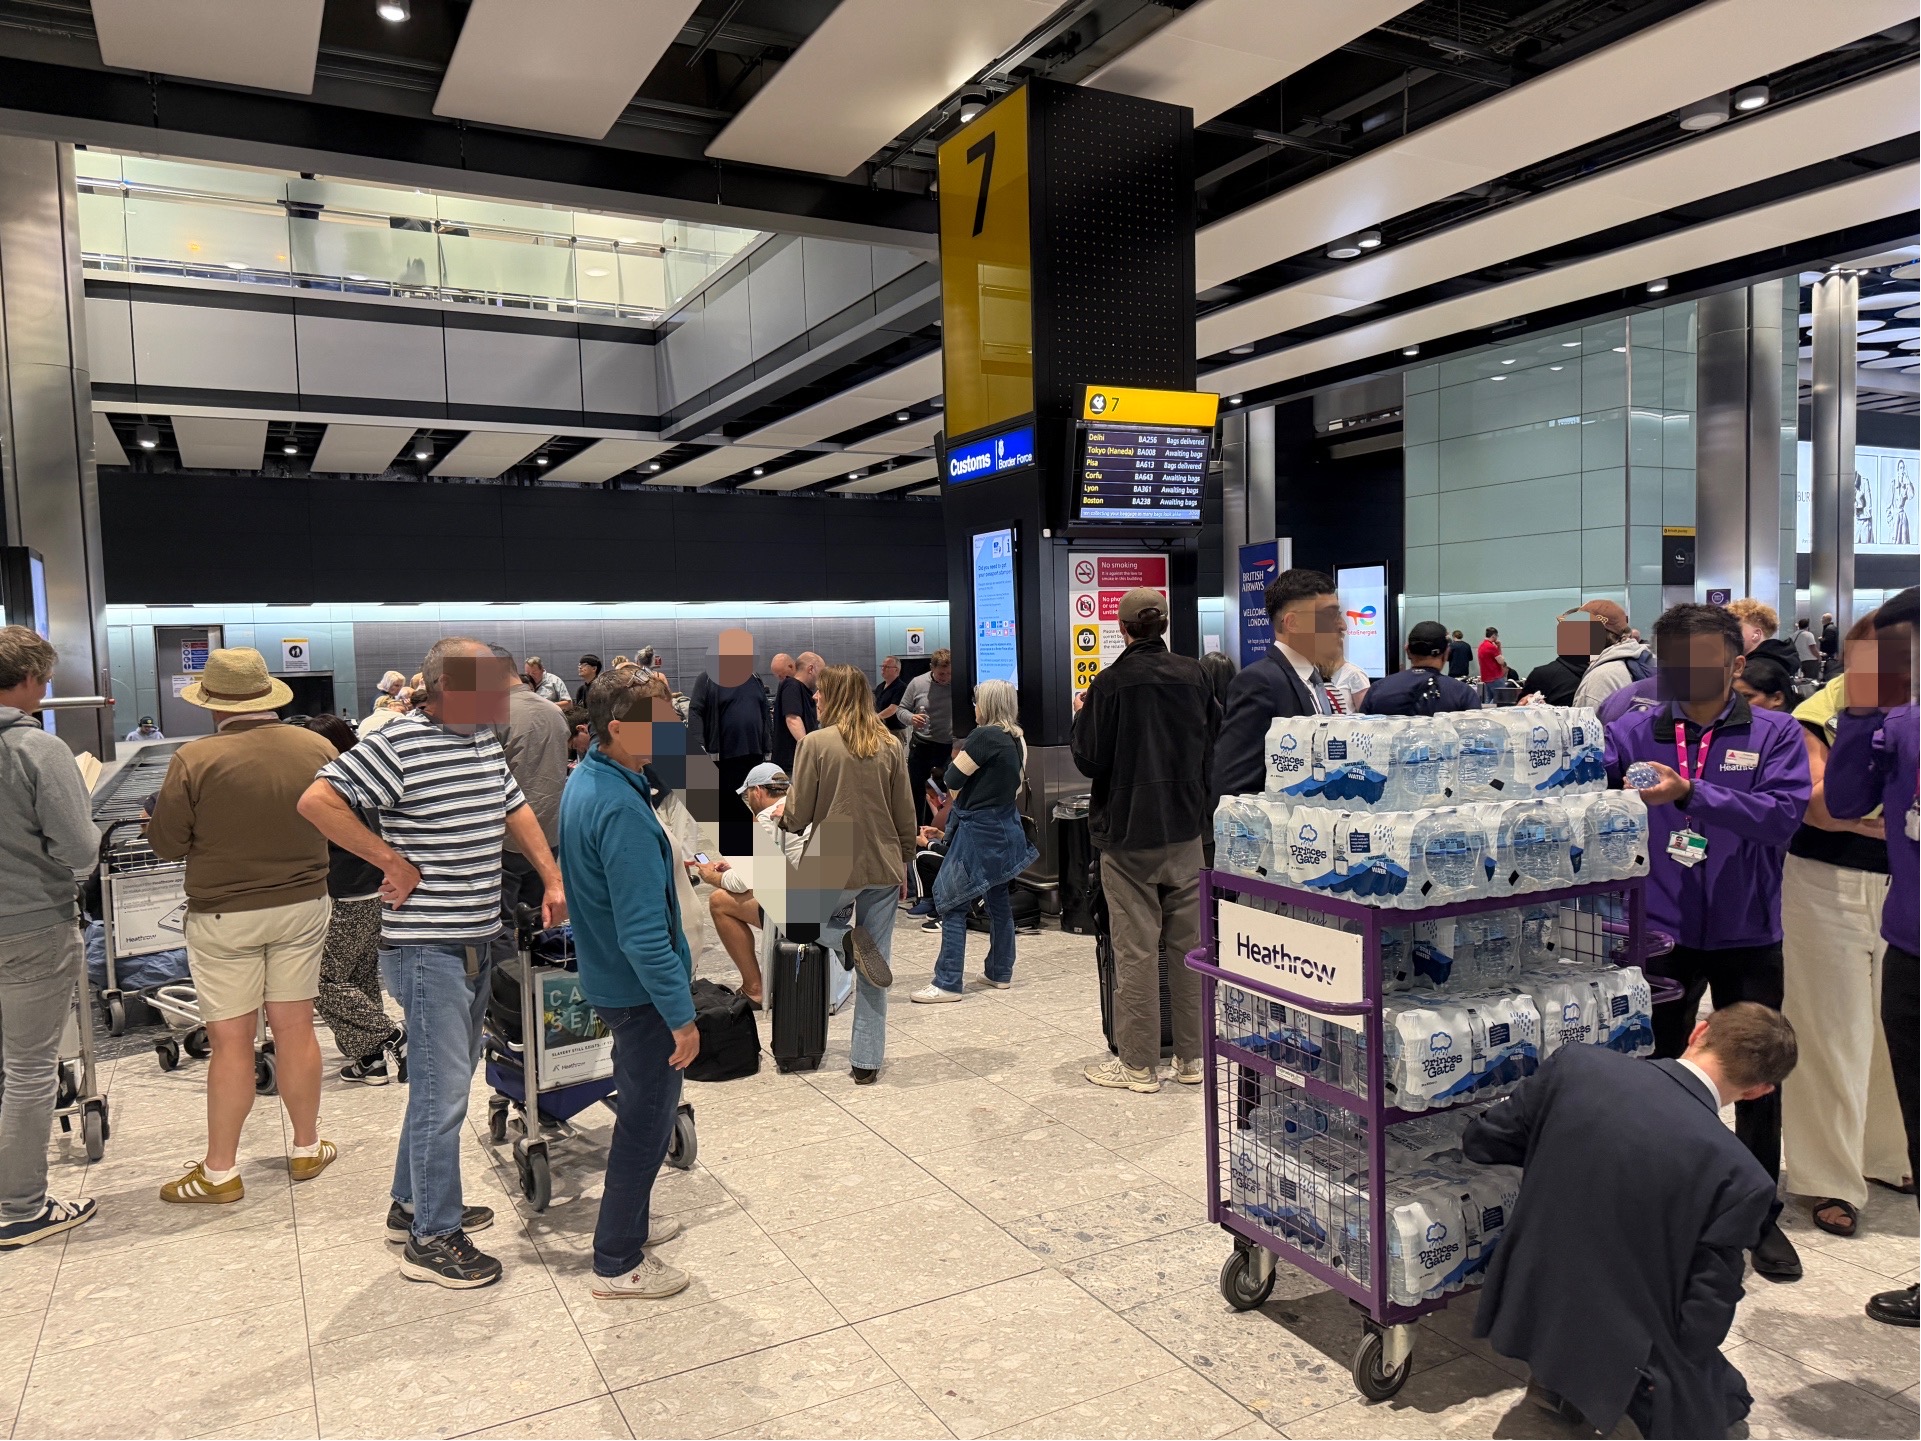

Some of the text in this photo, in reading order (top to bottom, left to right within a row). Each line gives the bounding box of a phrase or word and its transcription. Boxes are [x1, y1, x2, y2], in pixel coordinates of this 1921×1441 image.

[966, 131, 996, 238] 7
[1111, 397, 1120, 412] 7
[1088, 433, 1205, 446] Delhi BA256 Bags delivered
[1088, 446, 1203, 459] Tokyo (Haneda) BA008 Awaiting bags
[950, 452, 1032, 476] Customs Border Force
[1136, 460, 1155, 468] BA613
[1164, 462, 1177, 470] Bags
[1178, 462, 1202, 470] delivered
[1085, 472, 1102, 480] Corfu
[1162, 474, 1187, 483] Awaiting
[1187, 474, 1200, 483] bags
[1084, 484, 1099, 492] Lyon
[1160, 486, 1186, 495] Awaiting
[1186, 486, 1199, 495] bags
[1082, 496, 1104, 504] Boston
[1160, 498, 1184, 507] Awaiting
[1185, 498, 1198, 507] bags
[1112, 562, 1138, 570] smoking
[1242, 570, 1264, 582] BRITISH
[1242, 581, 1265, 592] AIRWAYS
[1243, 608, 1267, 616] WELCOME
[1248, 618, 1270, 627] LONDON
[1271, 754, 1305, 767] Princes
[1528, 749, 1556, 766] Princes
[1530, 756, 1552, 768] Gate
[1276, 762, 1300, 772] Gate
[1352, 767, 1366, 776] STILL
[1720, 764, 1754, 772] Heathro
[1348, 773, 1364, 781] WATER
[1290, 844, 1328, 860] Princes
[1296, 854, 1320, 864] Gate
[1371, 866, 1387, 875] WATER
[1376, 860, 1388, 870] STILL
[126, 934, 157, 943] Heathrow
[1236, 932, 1336, 986] Heathrow
[550, 986, 582, 1006] CA
[1223, 1002, 1252, 1021] Princes
[561, 1062, 586, 1070] Heathrow
[1422, 1054, 1462, 1072] Princes
[1427, 1062, 1456, 1078] Gate
[1418, 1242, 1459, 1264] Princes
[1424, 1252, 1452, 1270] Gate
